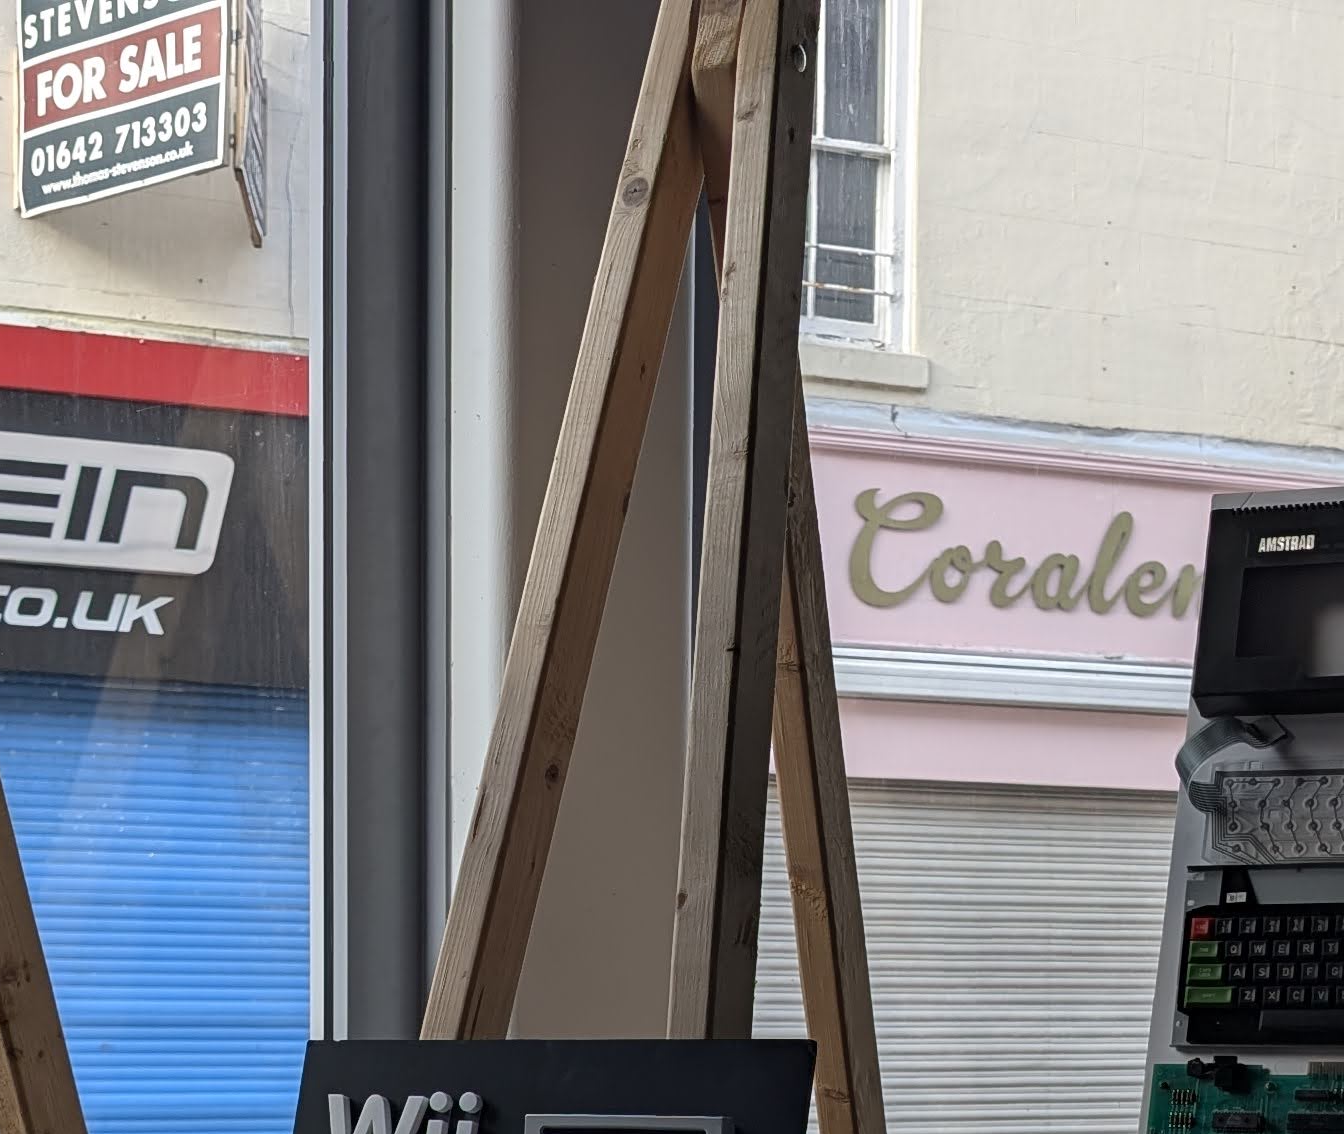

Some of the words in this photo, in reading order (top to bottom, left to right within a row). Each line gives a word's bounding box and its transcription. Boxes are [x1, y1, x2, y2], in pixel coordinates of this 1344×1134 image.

[36, 56, 107, 117] FOR
[118, 24, 203, 94] SALE
[30, 131, 104, 177] 01642
[114, 101, 207, 154] 713303
[1258, 534, 1315, 552] AMSTRAD
